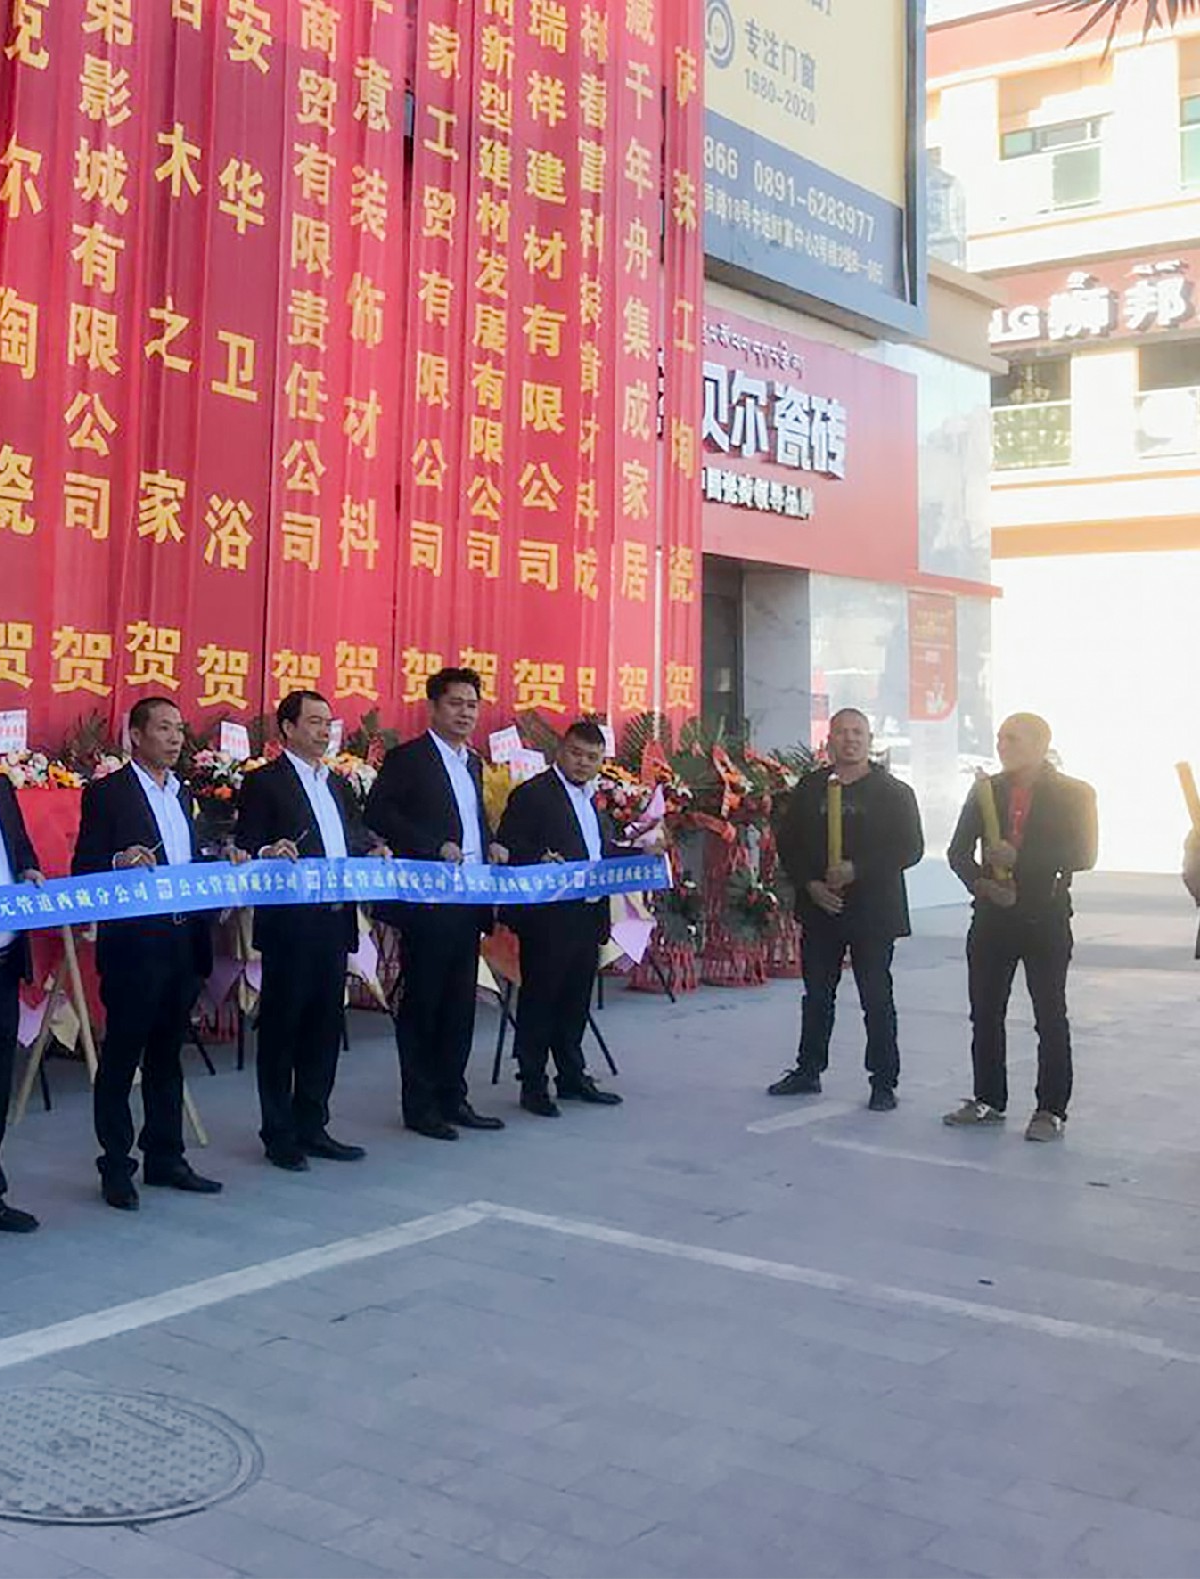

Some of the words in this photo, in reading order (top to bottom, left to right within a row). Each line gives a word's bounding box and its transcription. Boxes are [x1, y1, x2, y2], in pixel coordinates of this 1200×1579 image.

[754, 160, 875, 242] 0891-6283977
[204, 0, 273, 572] 安华卫浴
[280, 0, 341, 571] 商贸有限责任公司
[339, 0, 394, 570] 意装饰材料
[52, 625, 112, 696] 贺
[125, 622, 181, 691] 贺
[197, 644, 249, 709] 贺
[335, 641, 378, 701] 贺
[402, 647, 442, 703] 贺
[513, 659, 566, 714] 贺
[618, 662, 648, 711] 贺
[665, 661, 694, 709] 贺
